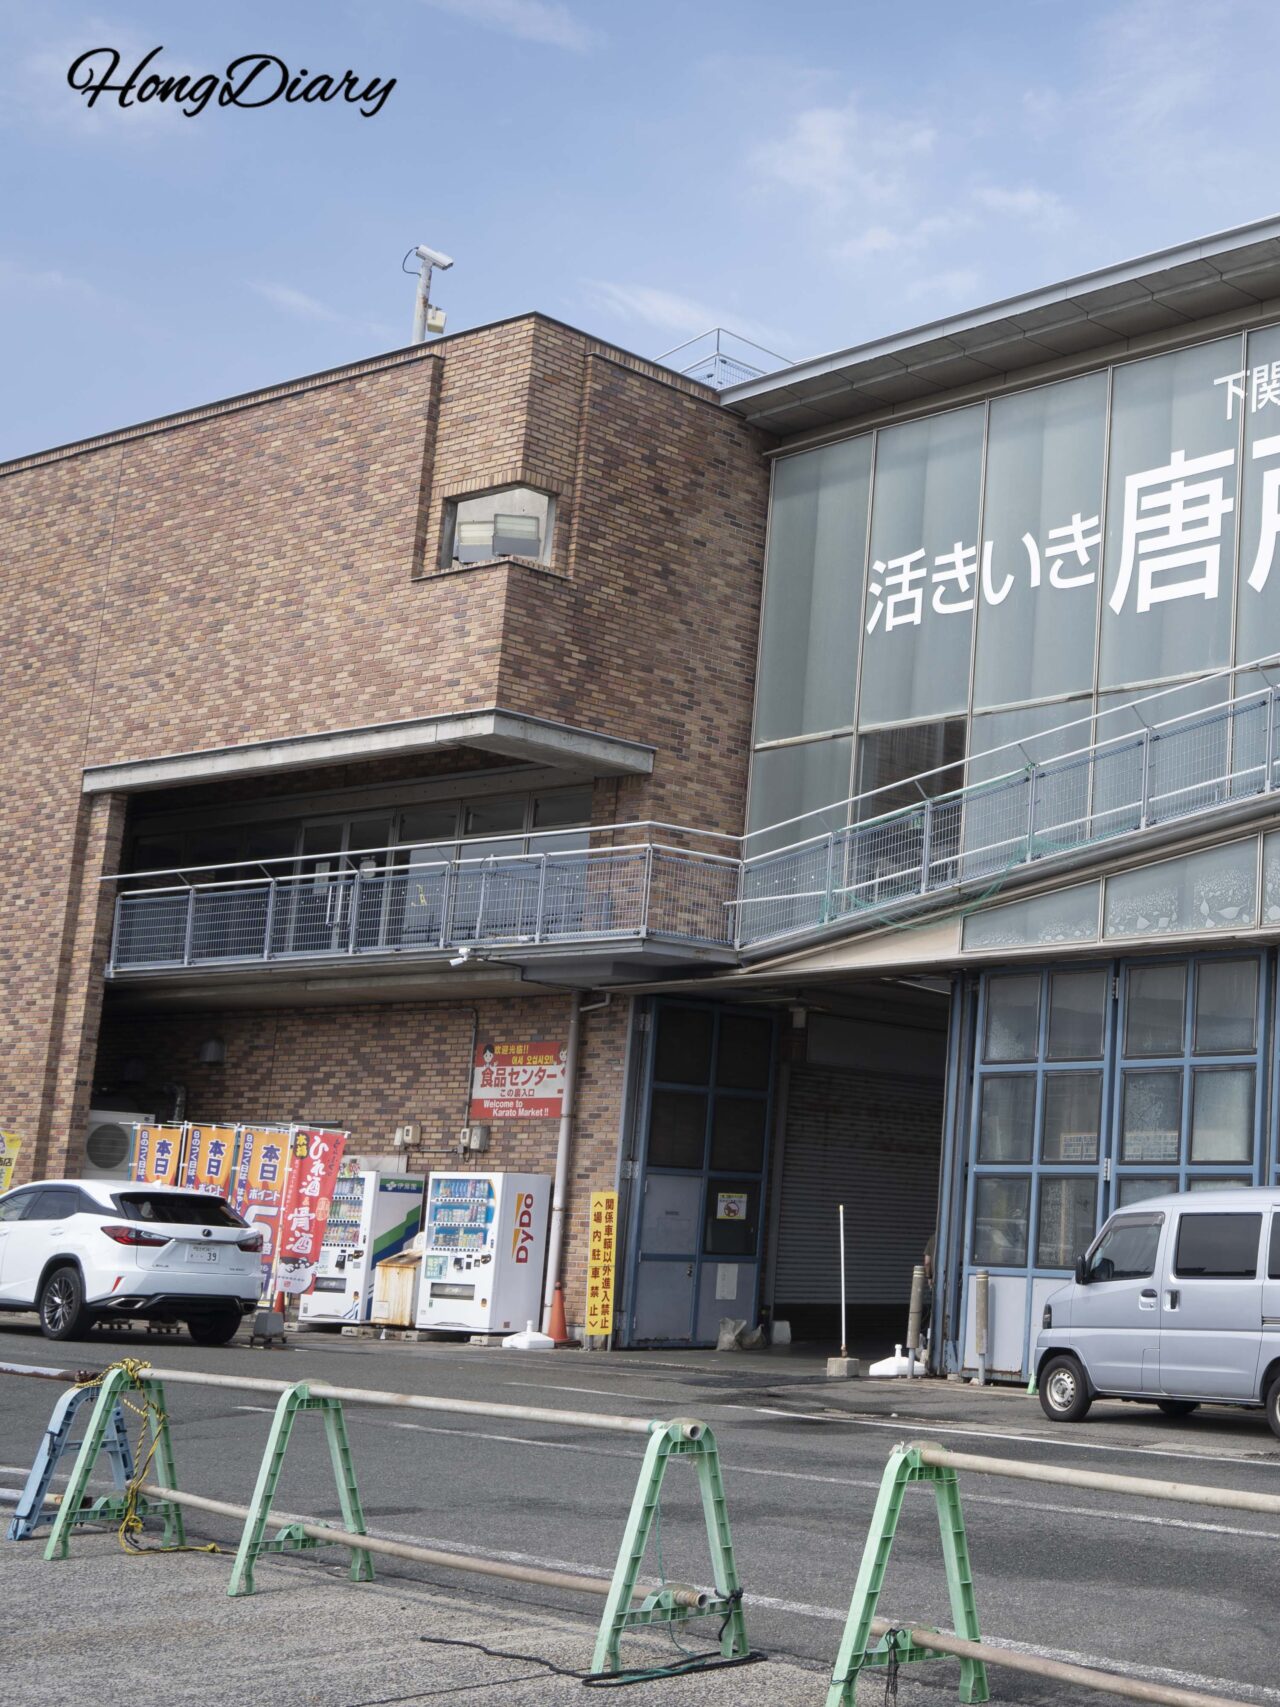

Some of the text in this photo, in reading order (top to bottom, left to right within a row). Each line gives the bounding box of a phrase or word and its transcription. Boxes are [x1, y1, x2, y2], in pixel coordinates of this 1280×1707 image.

[865, 513, 1102, 635] 活きいき
[481, 1067, 557, 1088] 食品センター
[483, 1099, 523, 1109] Welcome to
[492, 1108, 517, 1117] Karato
[518, 1108, 543, 1117] Market
[155, 1139, 173, 1176] 本日
[207, 1140, 226, 1177] 本日
[258, 1144, 281, 1183] 本日
[248, 1188, 280, 1202] ポイント
[516, 1193, 534, 1263] DyDo
